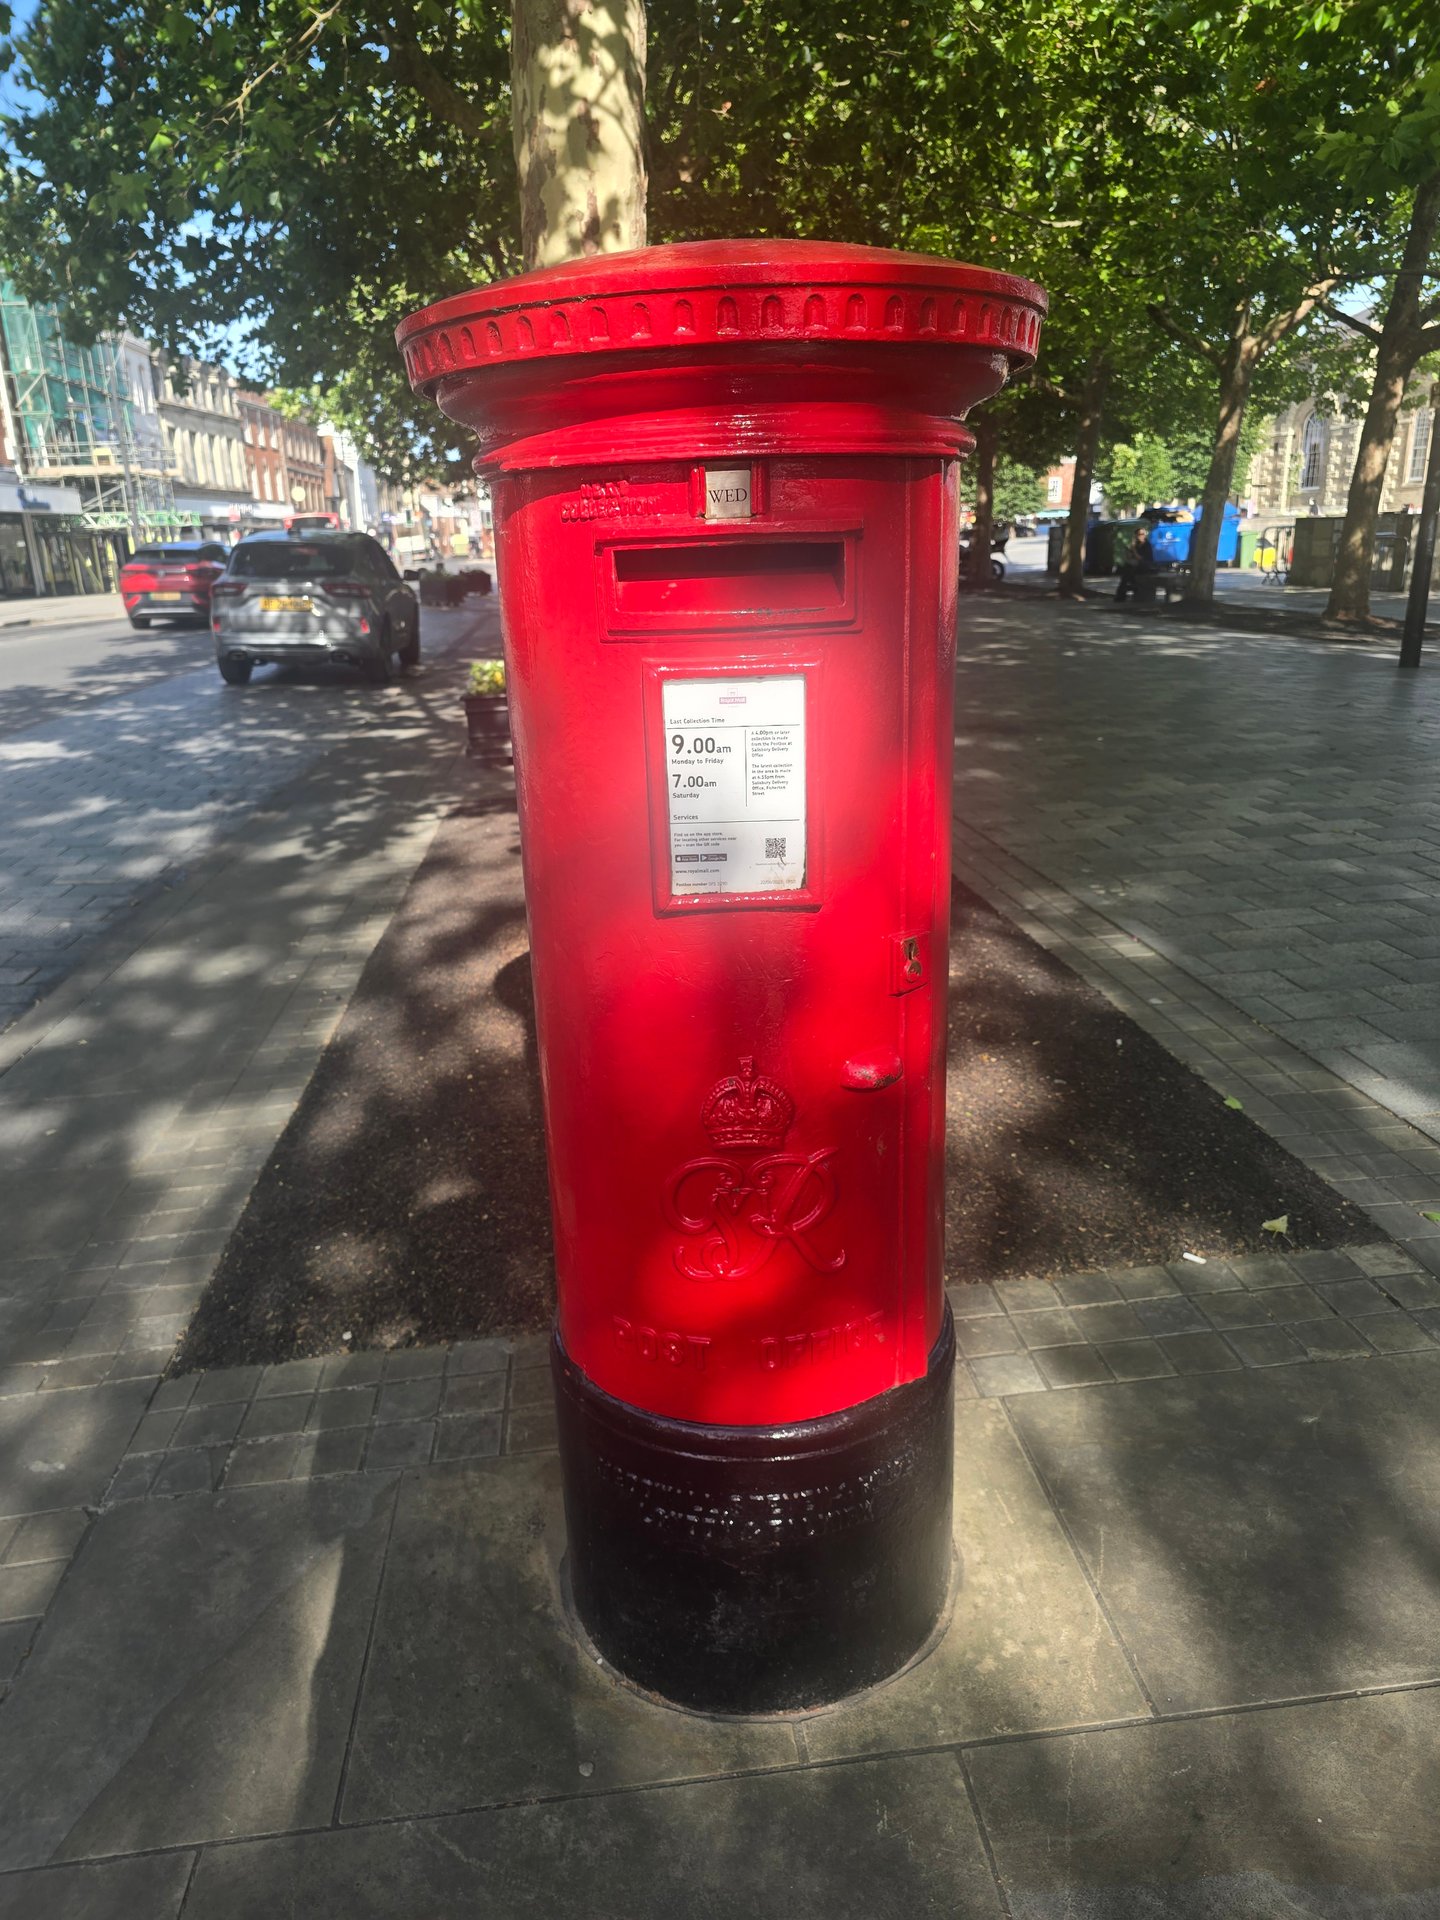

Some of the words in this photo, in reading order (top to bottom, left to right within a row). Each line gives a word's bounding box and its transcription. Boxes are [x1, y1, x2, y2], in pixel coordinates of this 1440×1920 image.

[708, 487, 748, 504] WED
[671, 734, 732, 755] 9.00am
[704, 757, 724, 765] Friday
[672, 774, 717, 788] 7.00am
[612, 1315, 712, 1371] POST
